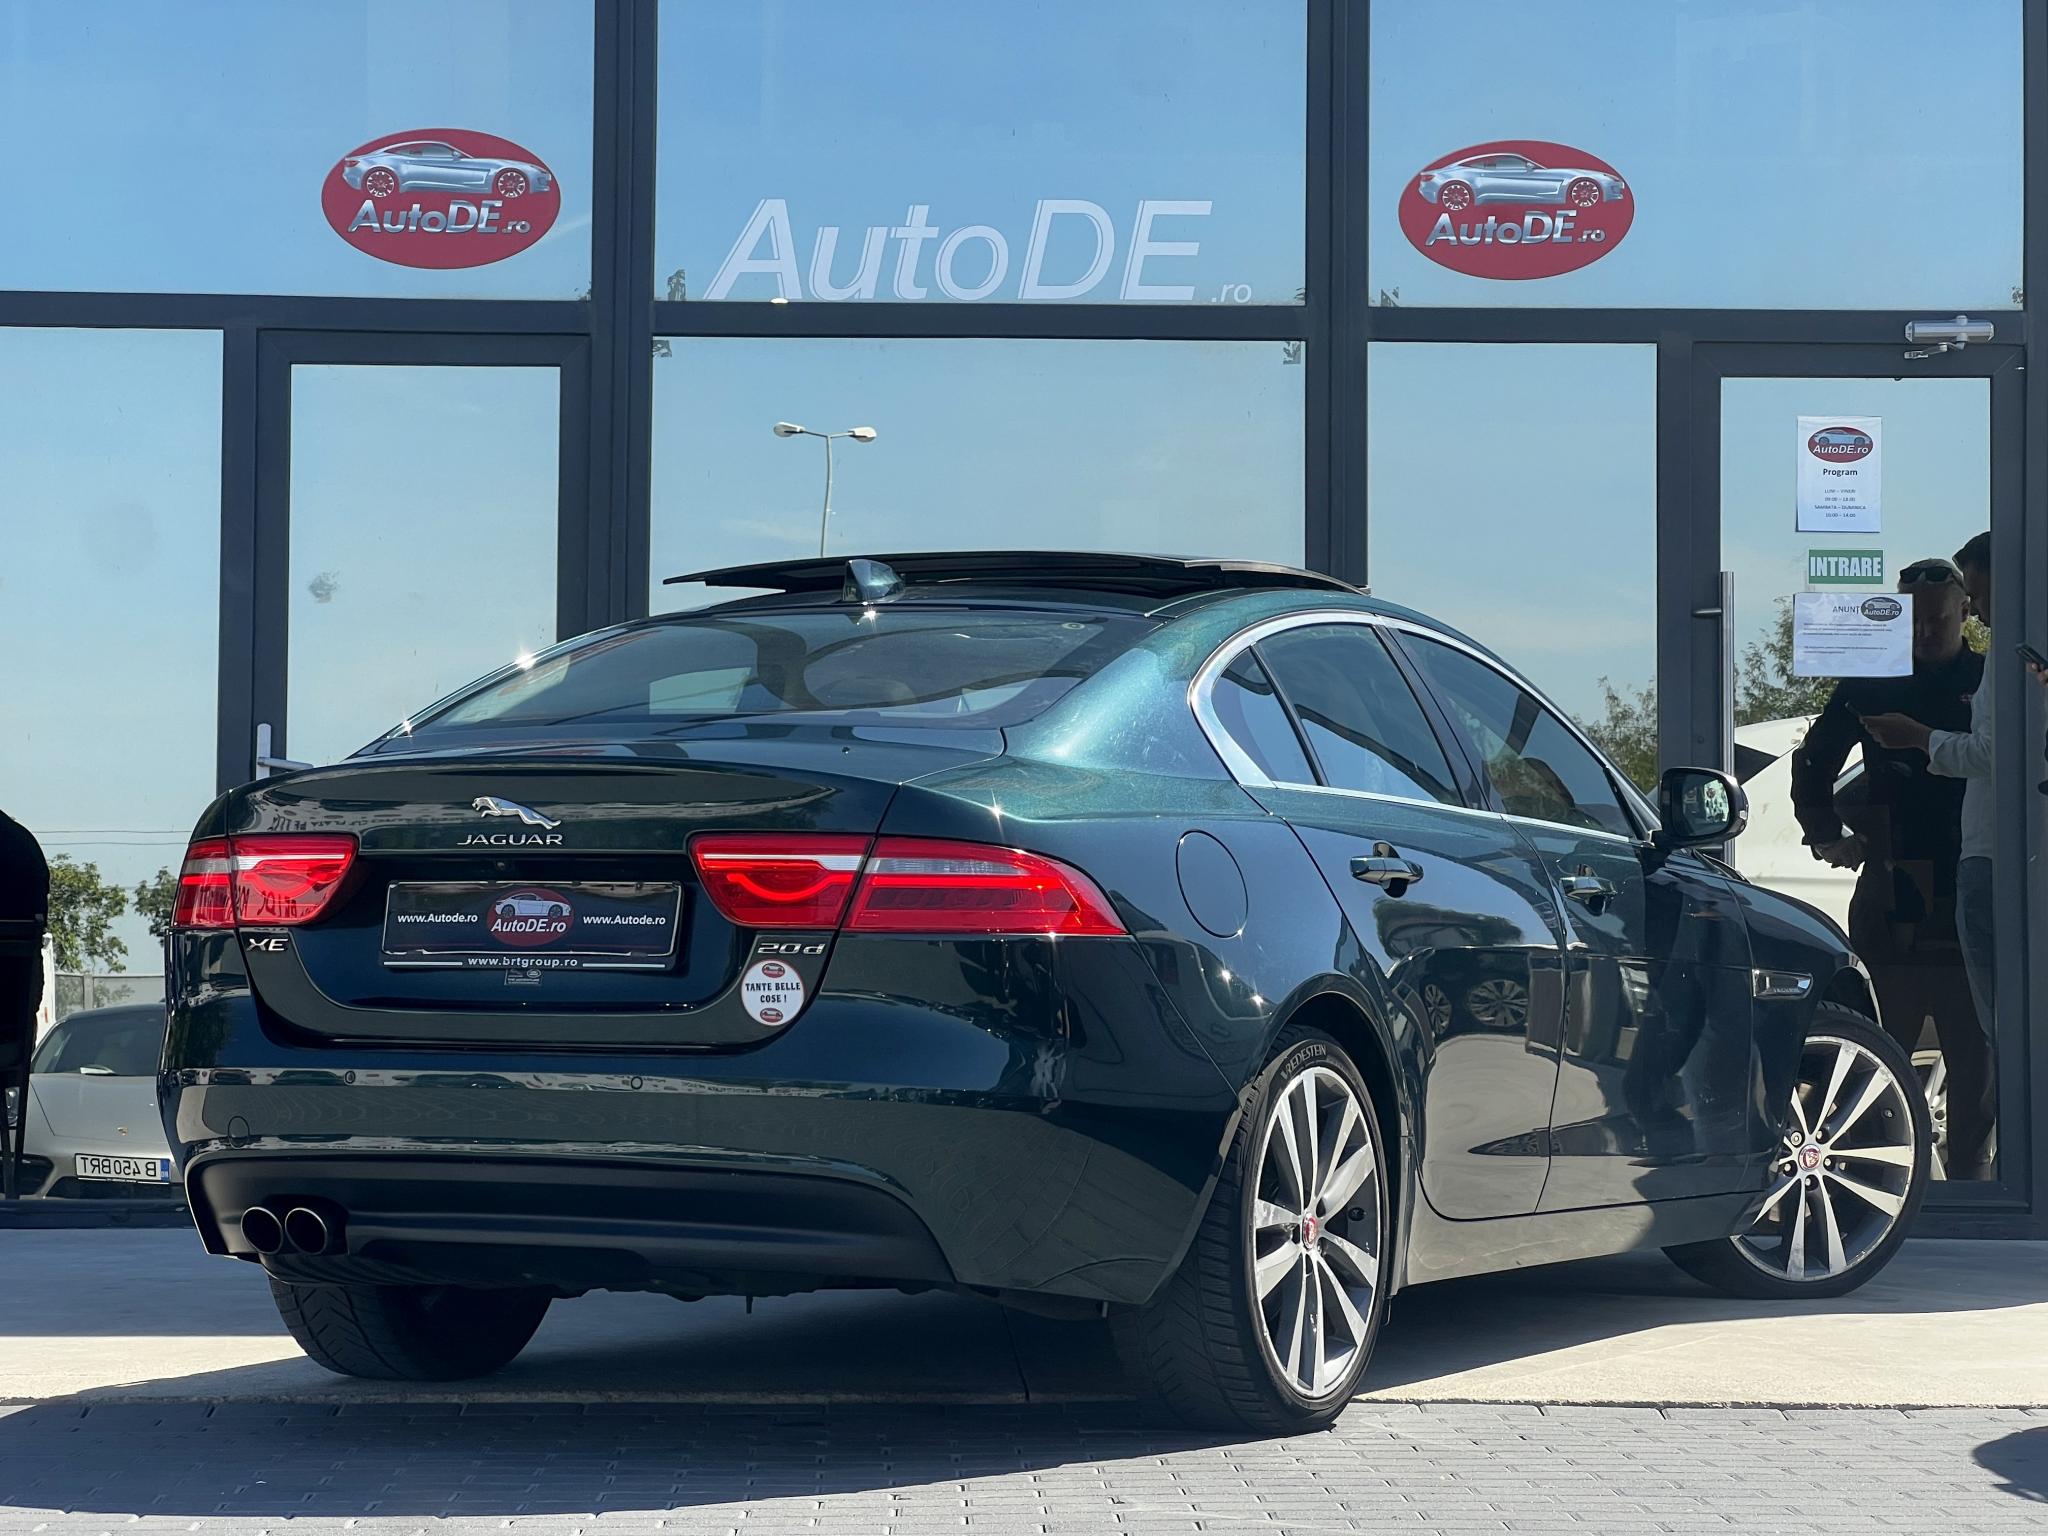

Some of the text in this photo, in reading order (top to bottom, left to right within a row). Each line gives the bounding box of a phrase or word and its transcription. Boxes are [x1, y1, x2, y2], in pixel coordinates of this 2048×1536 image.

[1812, 444, 1869, 455] AutoDE.ro
[1822, 468, 1858, 477] Program
[1809, 556, 1882, 577] INTRARE
[456, 833, 564, 846] JAGUAR
[397, 913, 478, 924] www.Autode.ro
[583, 915, 666, 926] www.Autode.ro
[490, 918, 567, 934] AutoDE.ro
[246, 938, 289, 951] XE
[757, 942, 826, 955] 20d
[467, 956, 578, 968] www.brtgroup.ro
[745, 982, 801, 991] TANTE BELLE
[760, 994, 782, 1003] COSE
